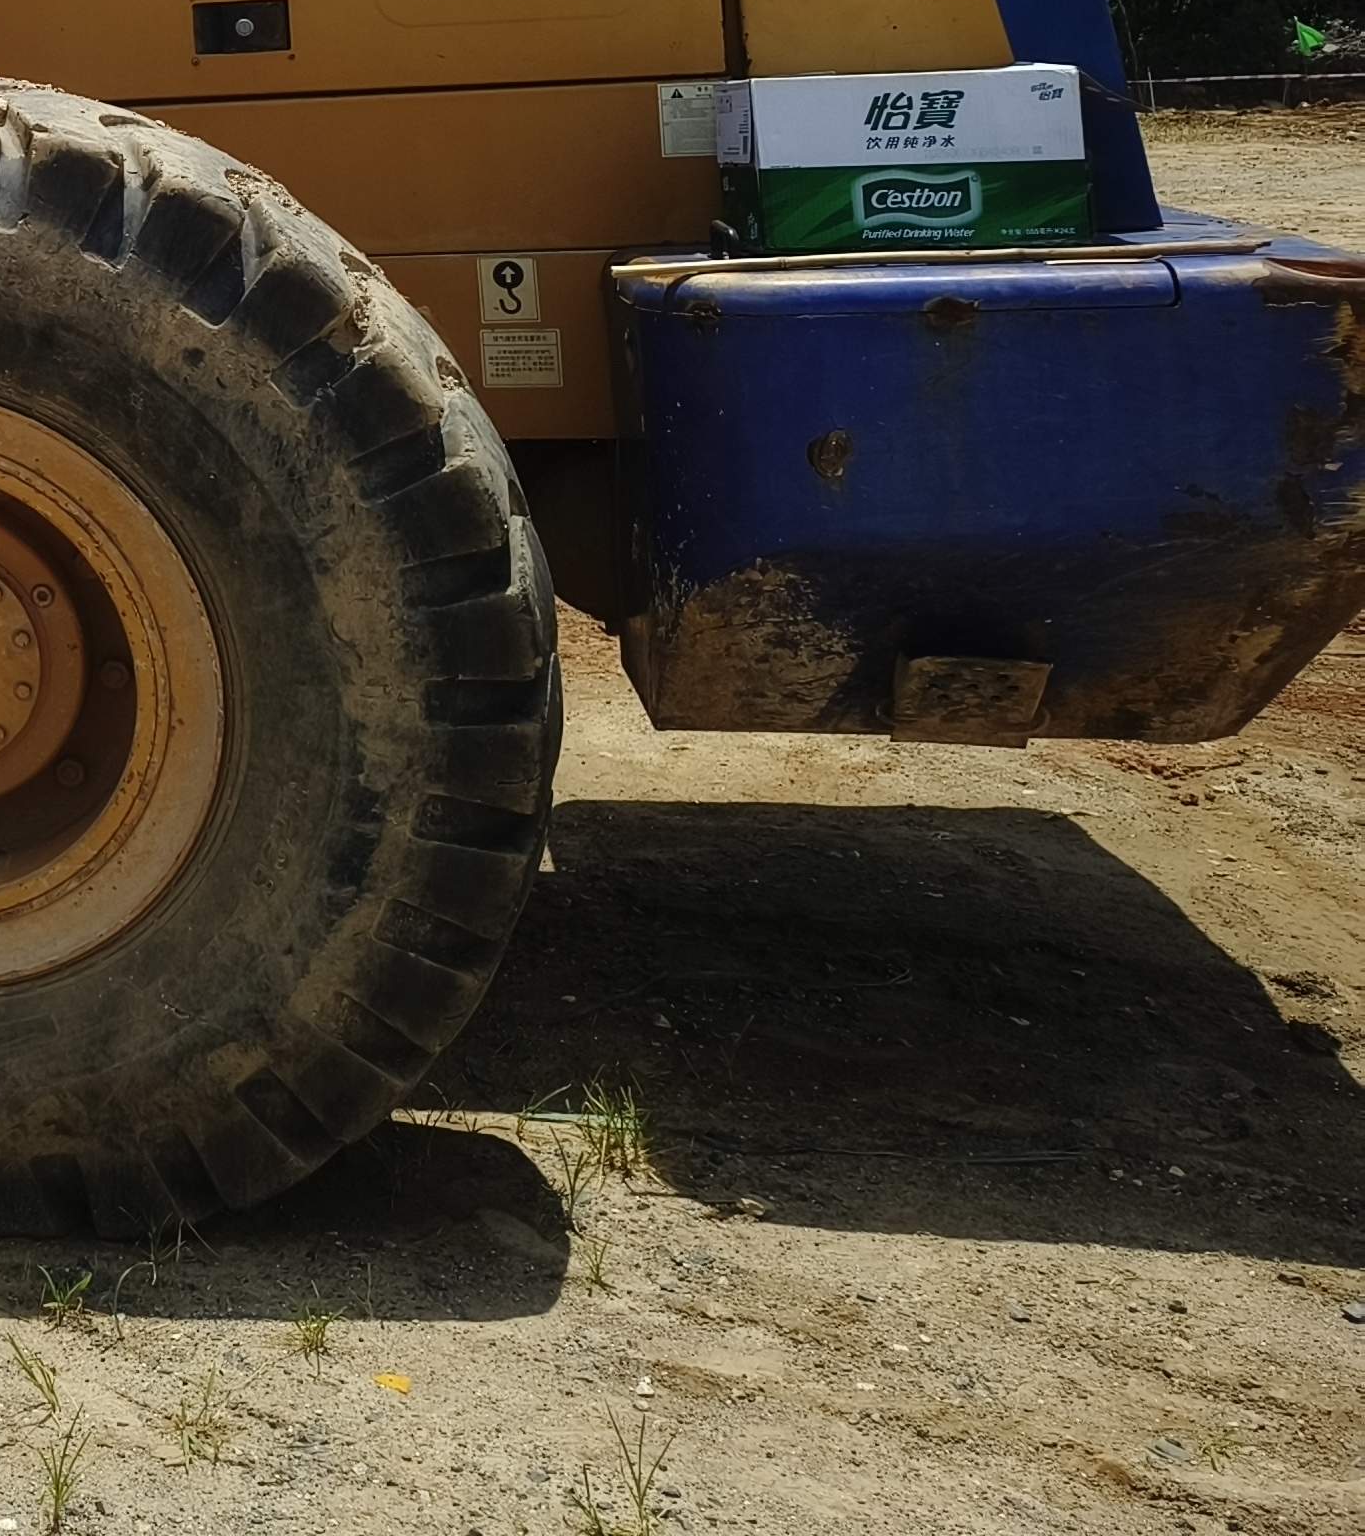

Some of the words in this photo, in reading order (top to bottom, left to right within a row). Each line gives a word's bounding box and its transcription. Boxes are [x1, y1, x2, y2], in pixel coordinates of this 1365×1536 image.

[865, 134, 956, 151] 饮用纯净水
[870, 187, 962, 209] C'estbon
[862, 228, 901, 239] Purified
[902, 228, 942, 241] Drinking
[943, 227, 975, 238] Water
